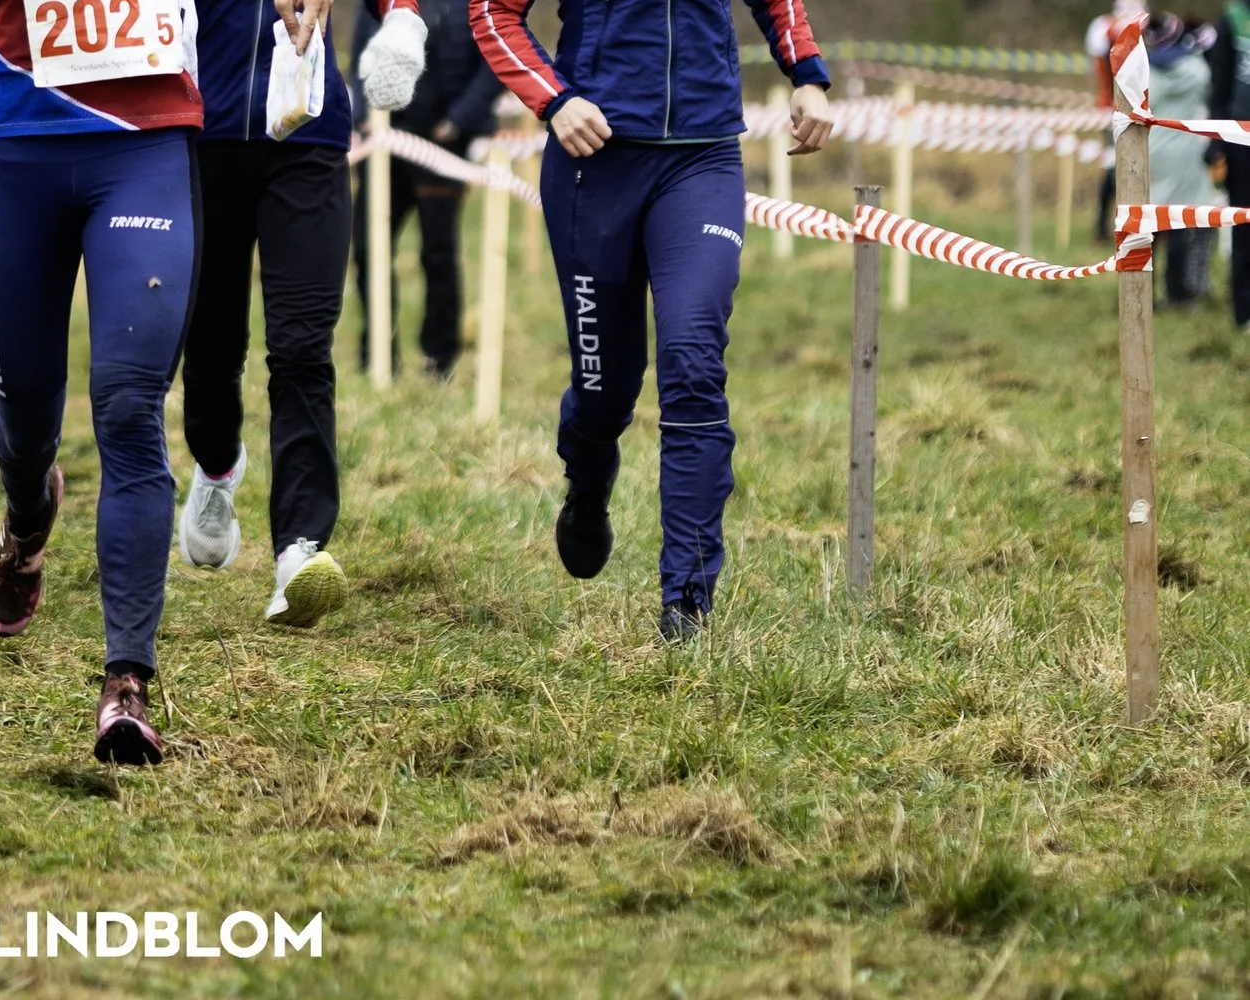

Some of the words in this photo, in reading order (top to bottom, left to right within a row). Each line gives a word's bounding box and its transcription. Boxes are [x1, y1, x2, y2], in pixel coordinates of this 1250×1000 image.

[156, 13, 174, 46] 5
[109, 216, 173, 231] TRIMTEX
[573, 274, 603, 391] HALDEN
